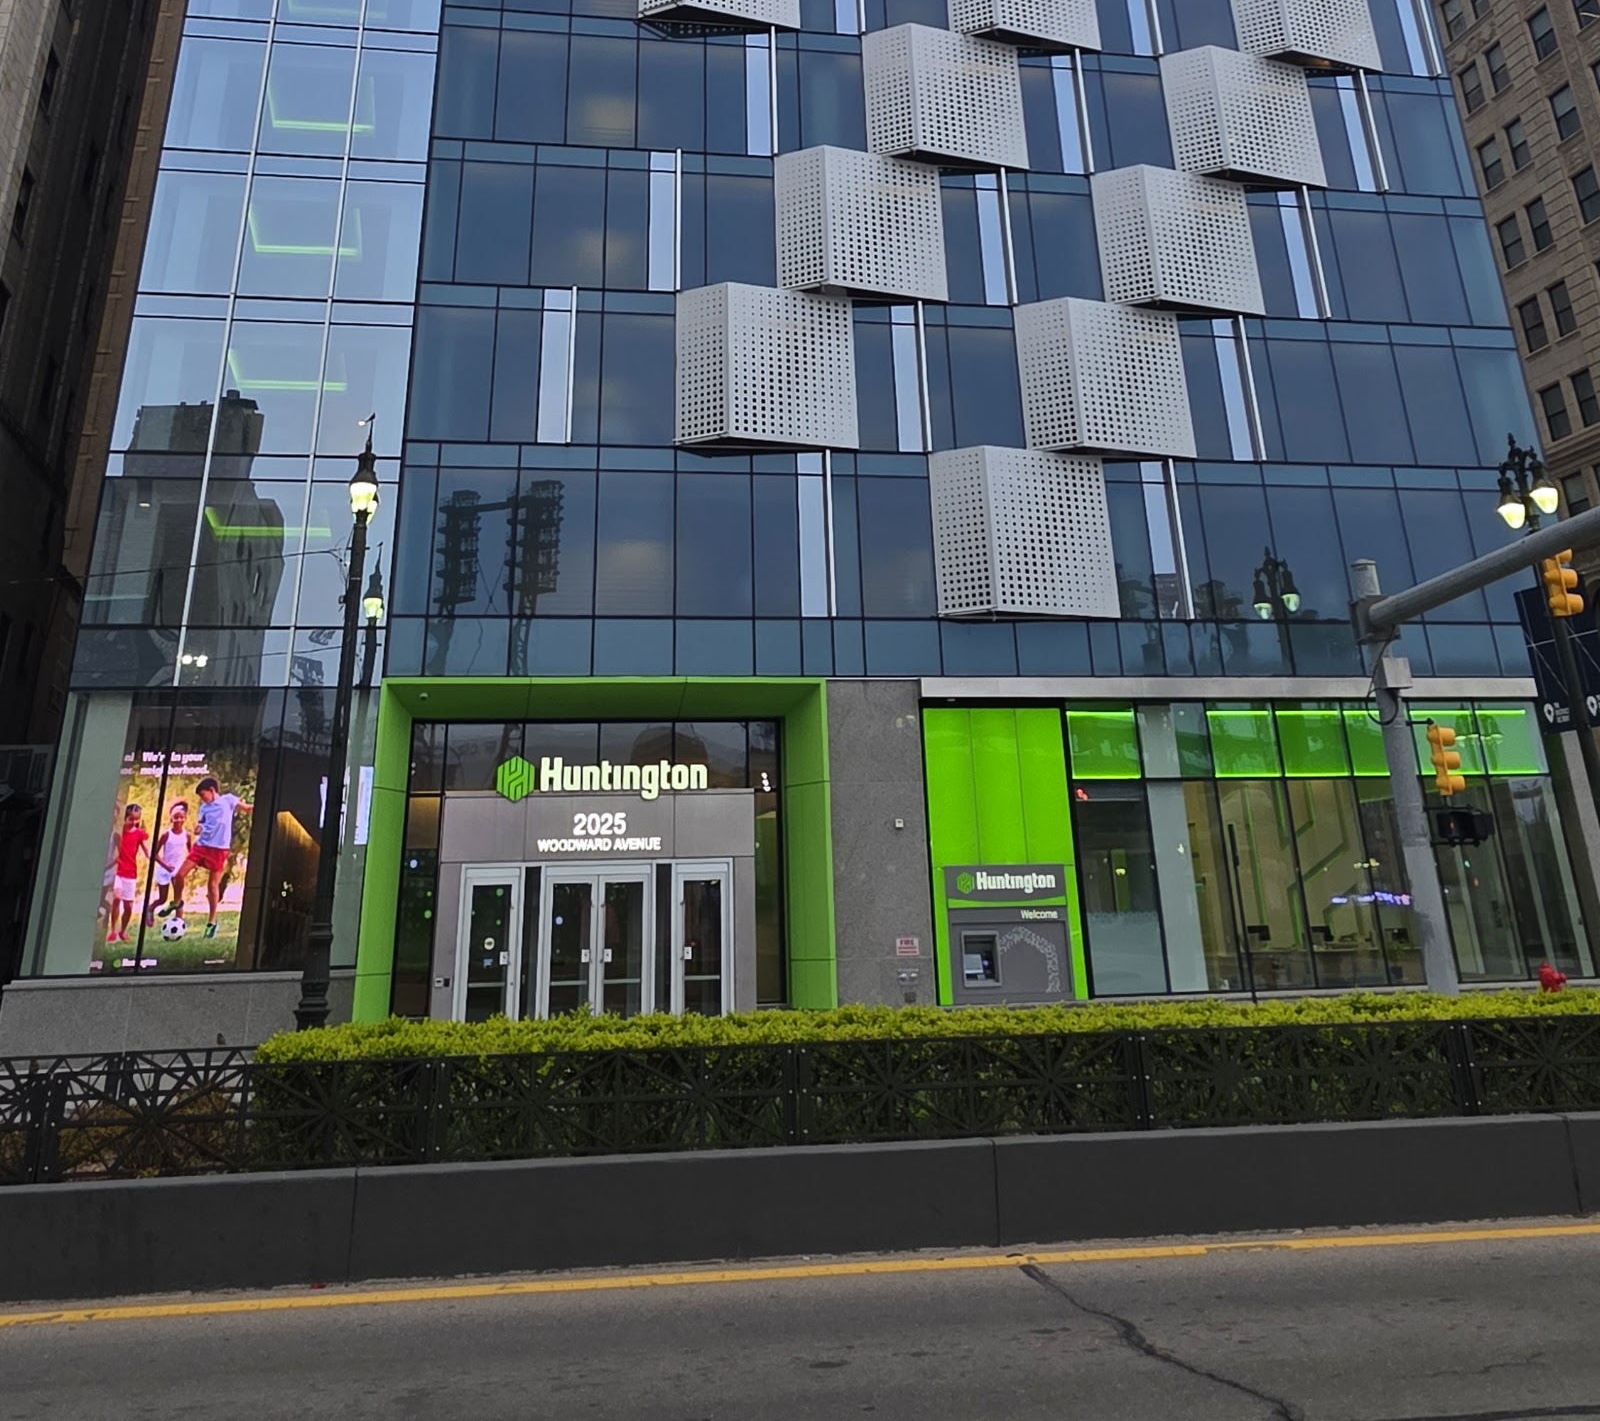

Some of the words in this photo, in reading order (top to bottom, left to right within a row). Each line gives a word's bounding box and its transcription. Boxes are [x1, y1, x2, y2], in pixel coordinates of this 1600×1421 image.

[142, 751, 168, 762] We'r
[181, 753, 205, 764] your
[140, 764, 210, 777] neigborhood.
[540, 756, 708, 800] Huntington
[572, 812, 627, 835] 2025
[537, 838, 612, 852] WOODWARD
[613, 837, 662, 851] AVENUE
[976, 871, 1056, 894] Huntington
[1020, 909, 1058, 920] Welcome
